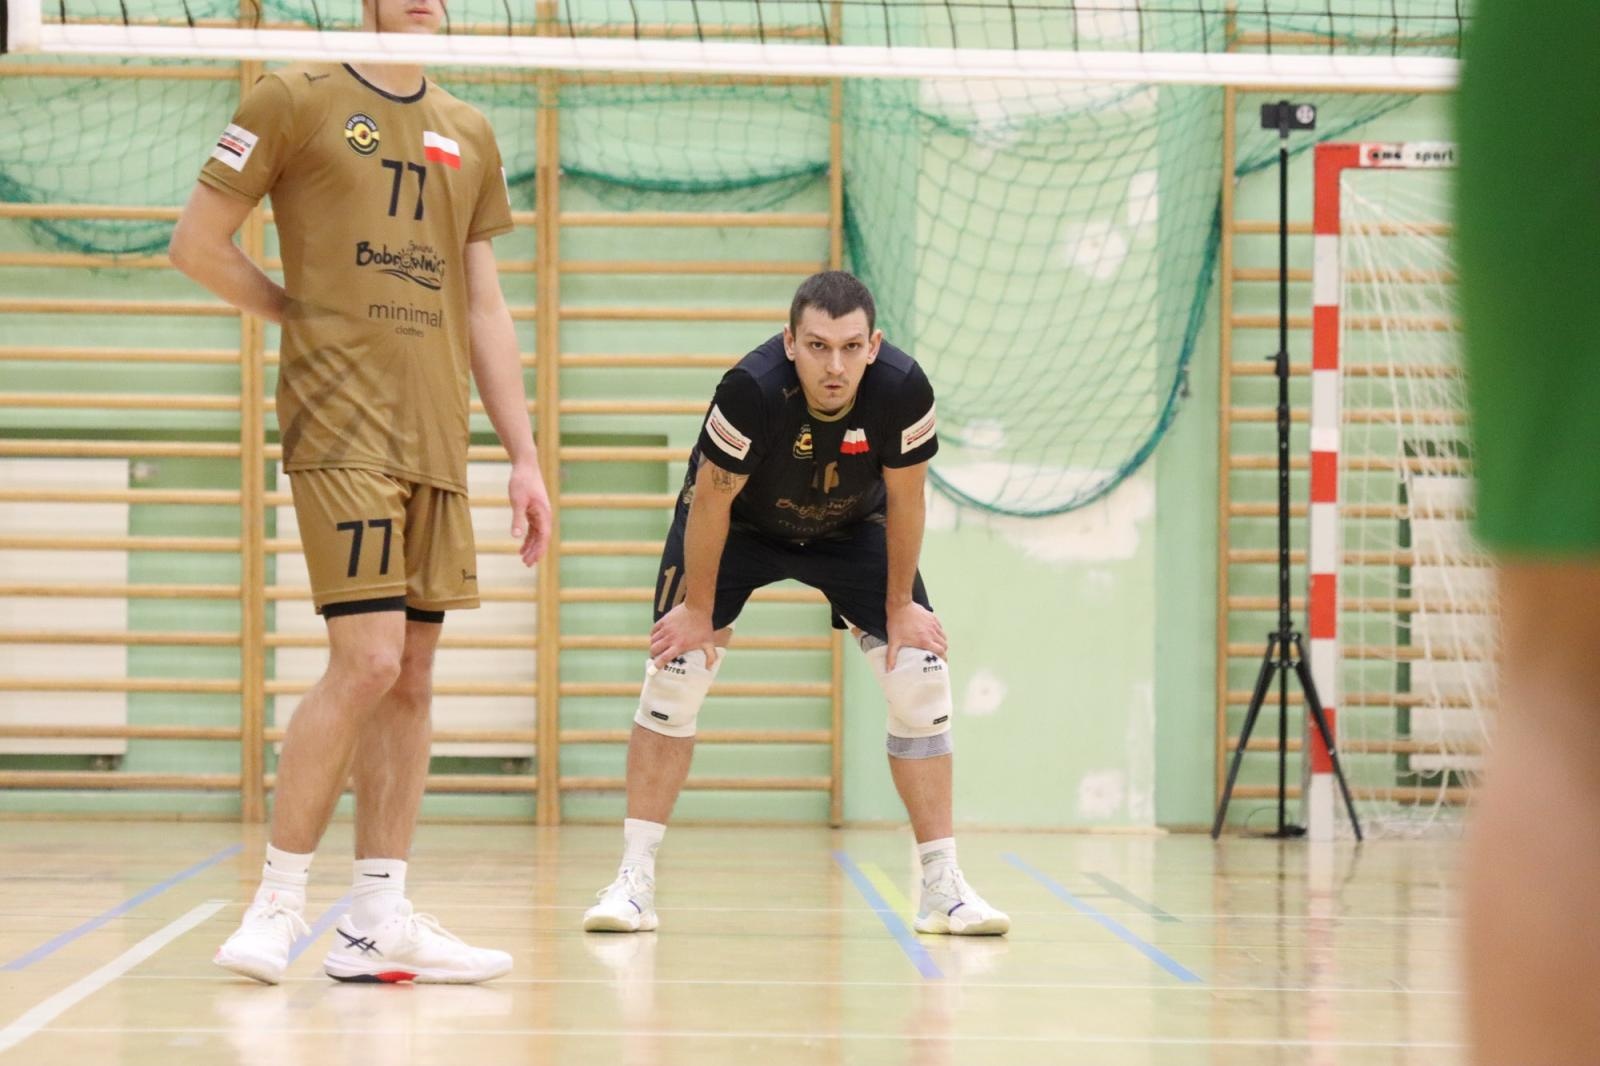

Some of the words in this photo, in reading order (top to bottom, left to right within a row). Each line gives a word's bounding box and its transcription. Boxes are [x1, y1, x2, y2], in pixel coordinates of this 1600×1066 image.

[381, 159, 426, 220] 77
[368, 300, 442, 328] minimal
[336, 518, 392, 577] 77
